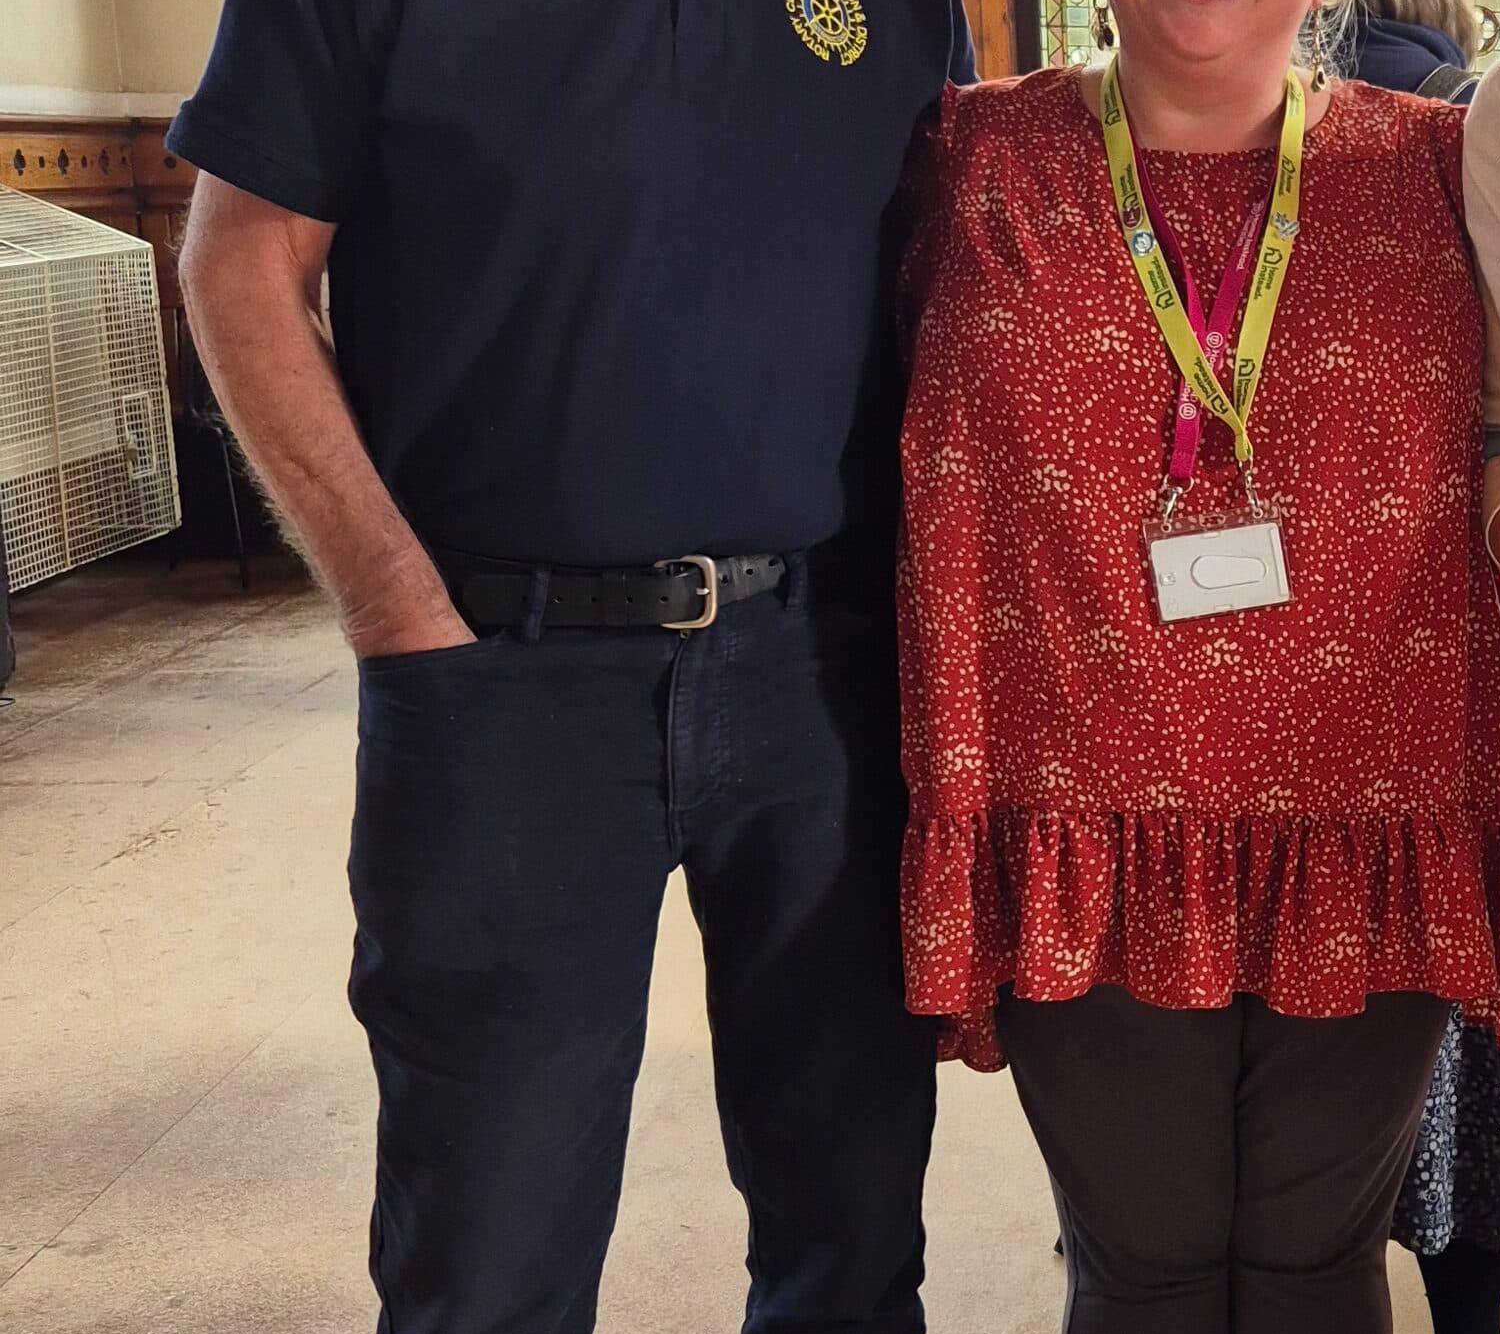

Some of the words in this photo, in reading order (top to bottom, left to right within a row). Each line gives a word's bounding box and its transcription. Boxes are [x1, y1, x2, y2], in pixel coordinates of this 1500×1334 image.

[855, 13, 866, 22] &
[790, 16, 829, 61] ROTARY
[840, 26, 868, 66] DISTRICT
